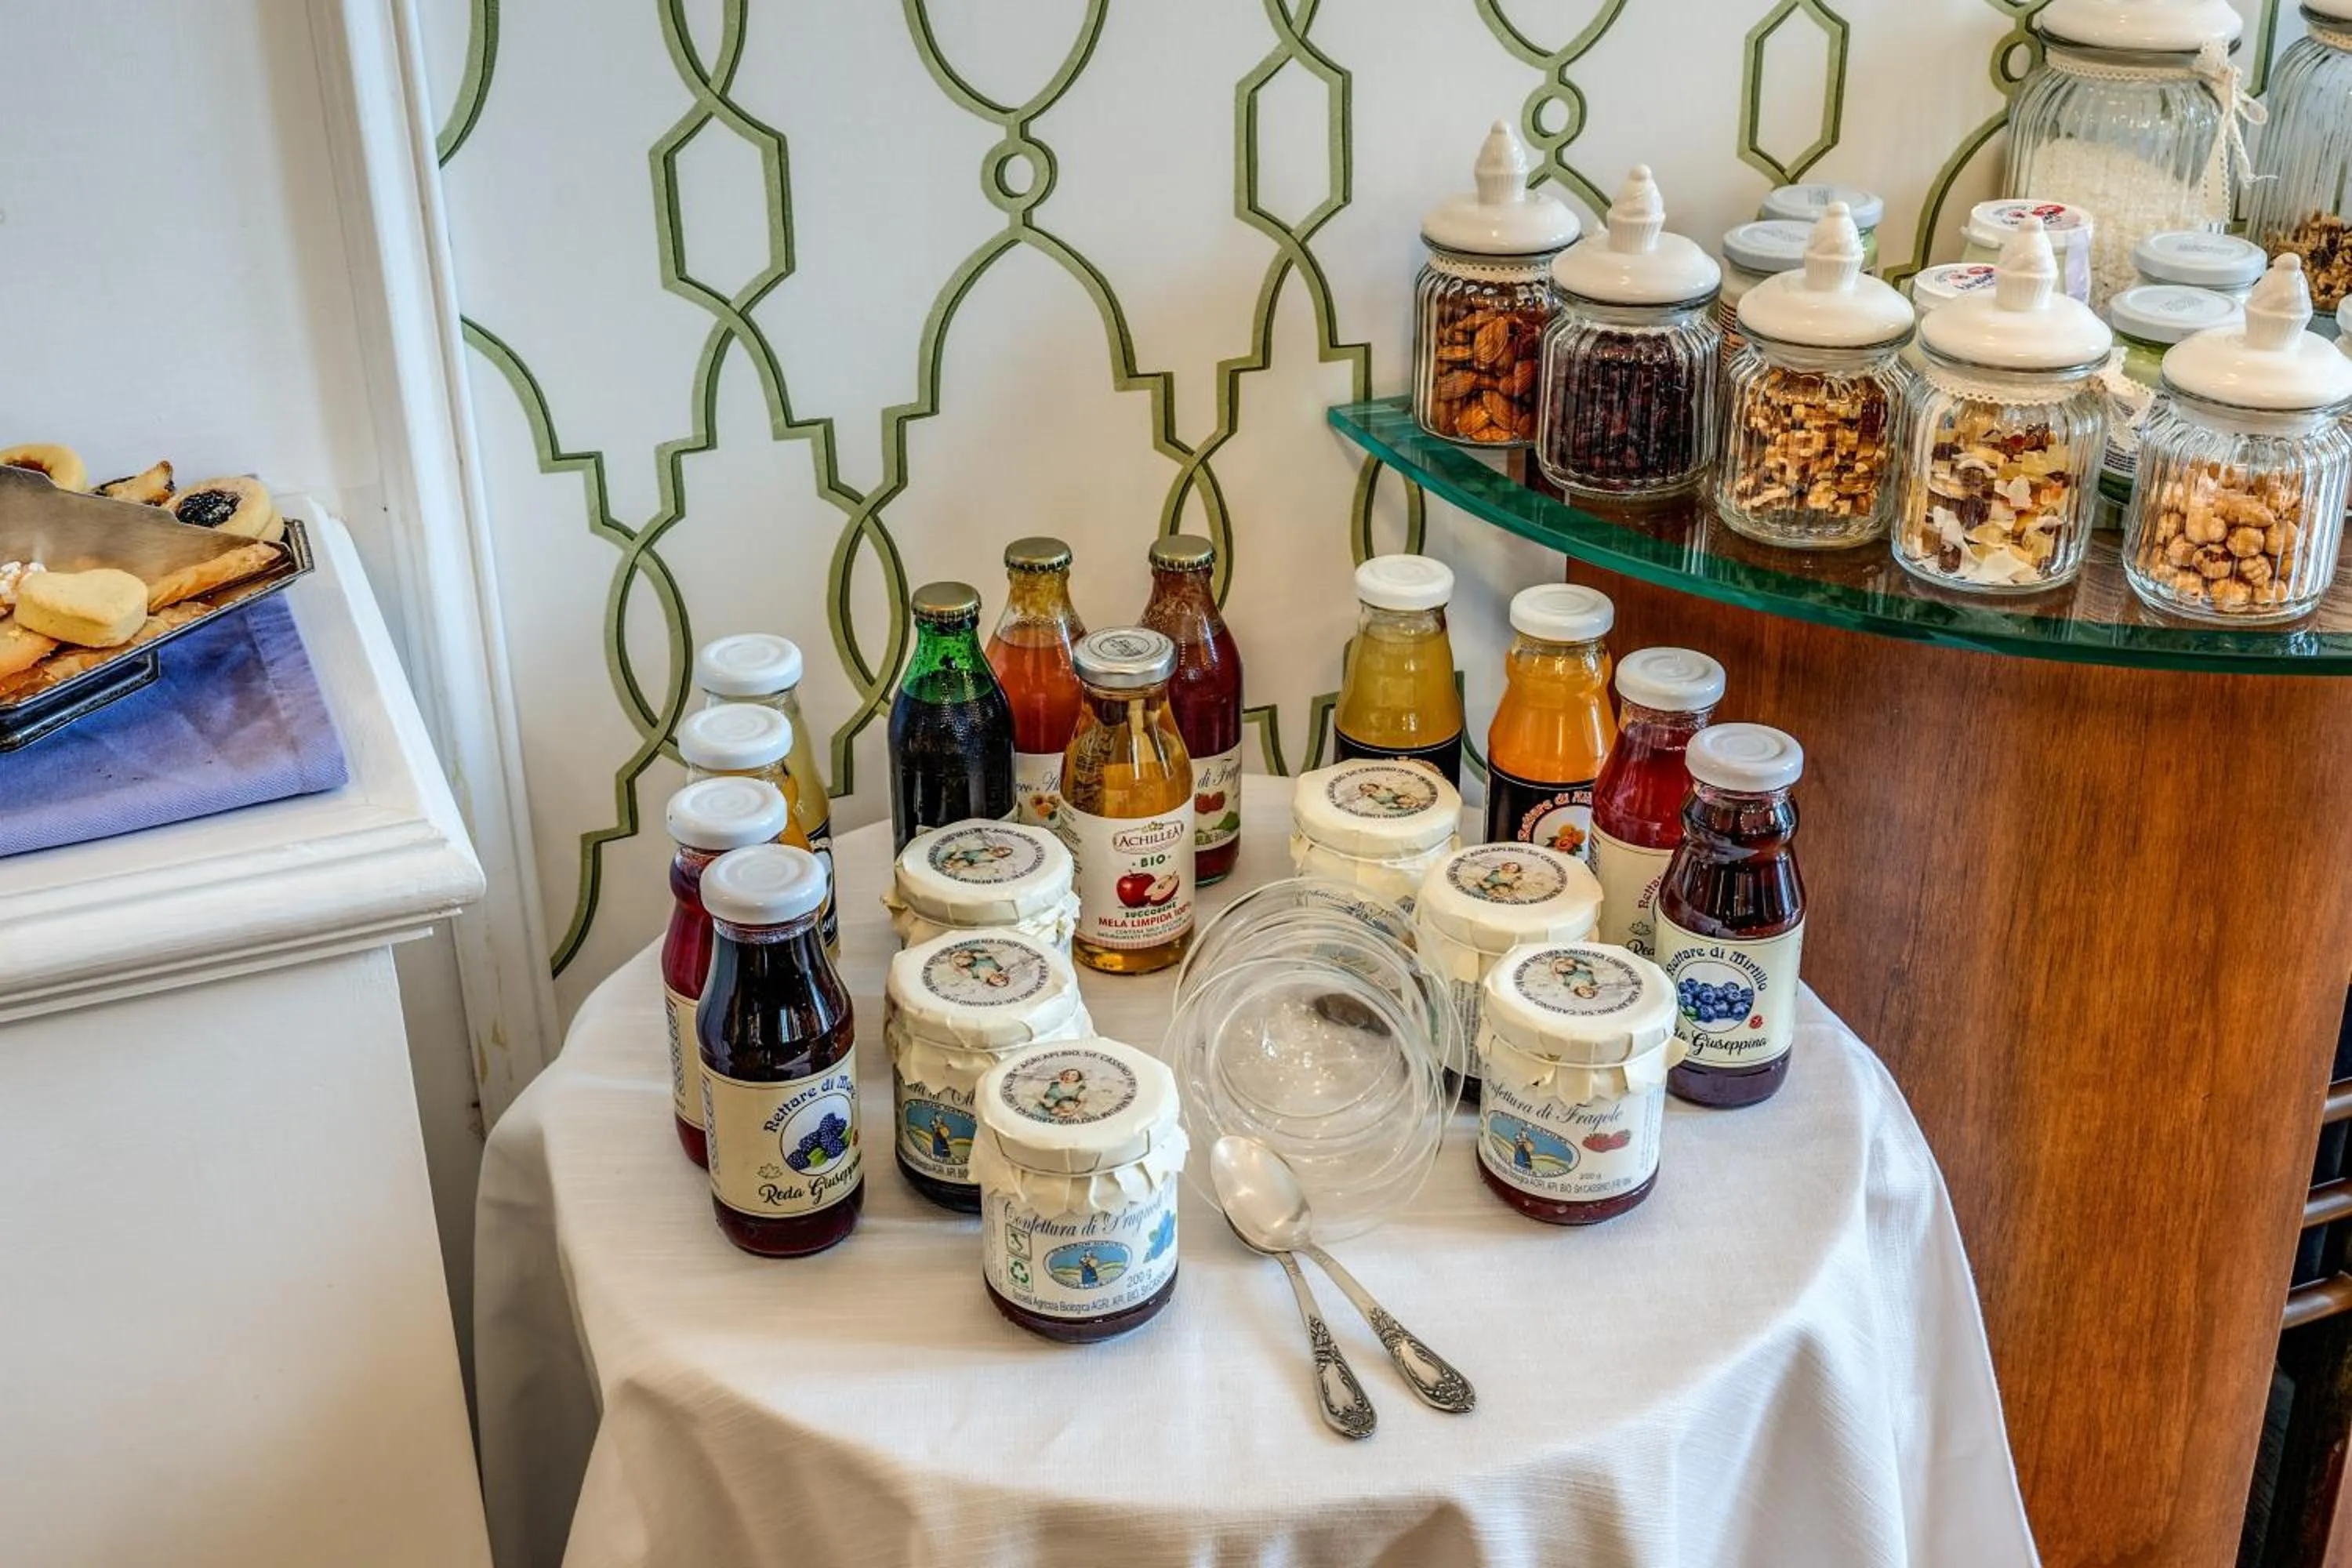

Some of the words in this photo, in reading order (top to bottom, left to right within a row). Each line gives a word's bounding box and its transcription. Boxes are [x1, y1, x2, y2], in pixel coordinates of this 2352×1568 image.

[1118, 825, 1179, 848] ACHILLEA
[1140, 854, 1166, 868] BIO
[1098, 917, 1128, 928] MELA
[1131, 910, 1172, 927] LIMPIDA
[1710, 946, 1726, 960] di
[1729, 950, 1769, 992] Mirtillo
[1691, 1029, 1769, 1056] Giuseppina
[822, 1077, 834, 1091] di
[1537, 1103, 1554, 1120] di
[757, 1183, 804, 1207] Reda
[1081, 1214, 1098, 1237] di
